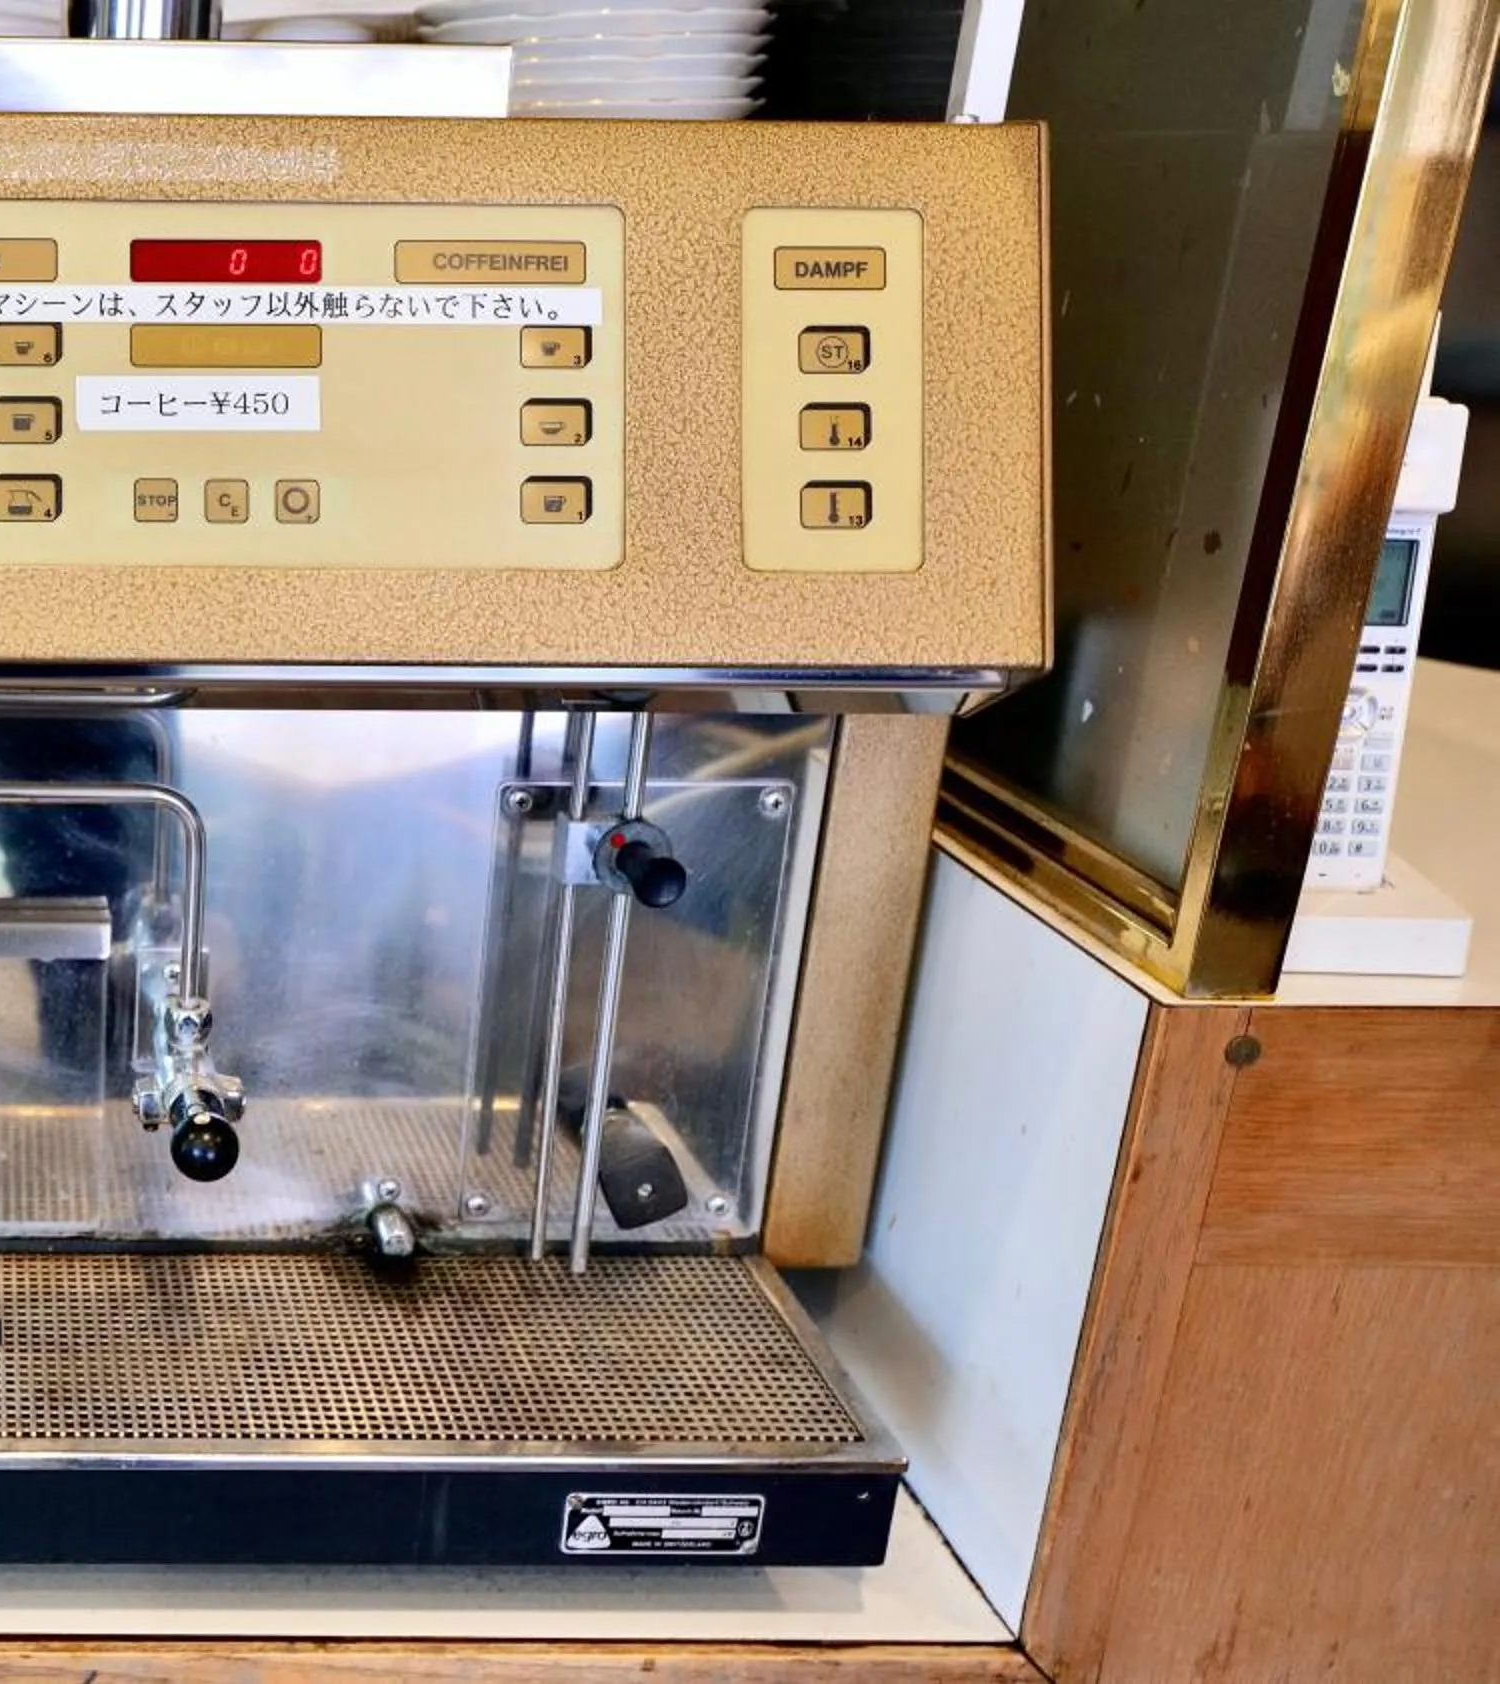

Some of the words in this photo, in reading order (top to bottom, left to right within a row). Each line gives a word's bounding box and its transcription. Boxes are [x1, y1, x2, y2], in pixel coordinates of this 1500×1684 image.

[229, 248, 247, 275] 0
[299, 248, 318, 275] 0
[432, 252, 569, 271] COFFEINFREI
[794, 261, 869, 279] DAMPF
[820, 344, 845, 359] ST
[44, 429, 52, 441] 5
[847, 436, 862, 447] 14
[137, 494, 177, 507] STOP
[43, 507, 53, 518] 4
